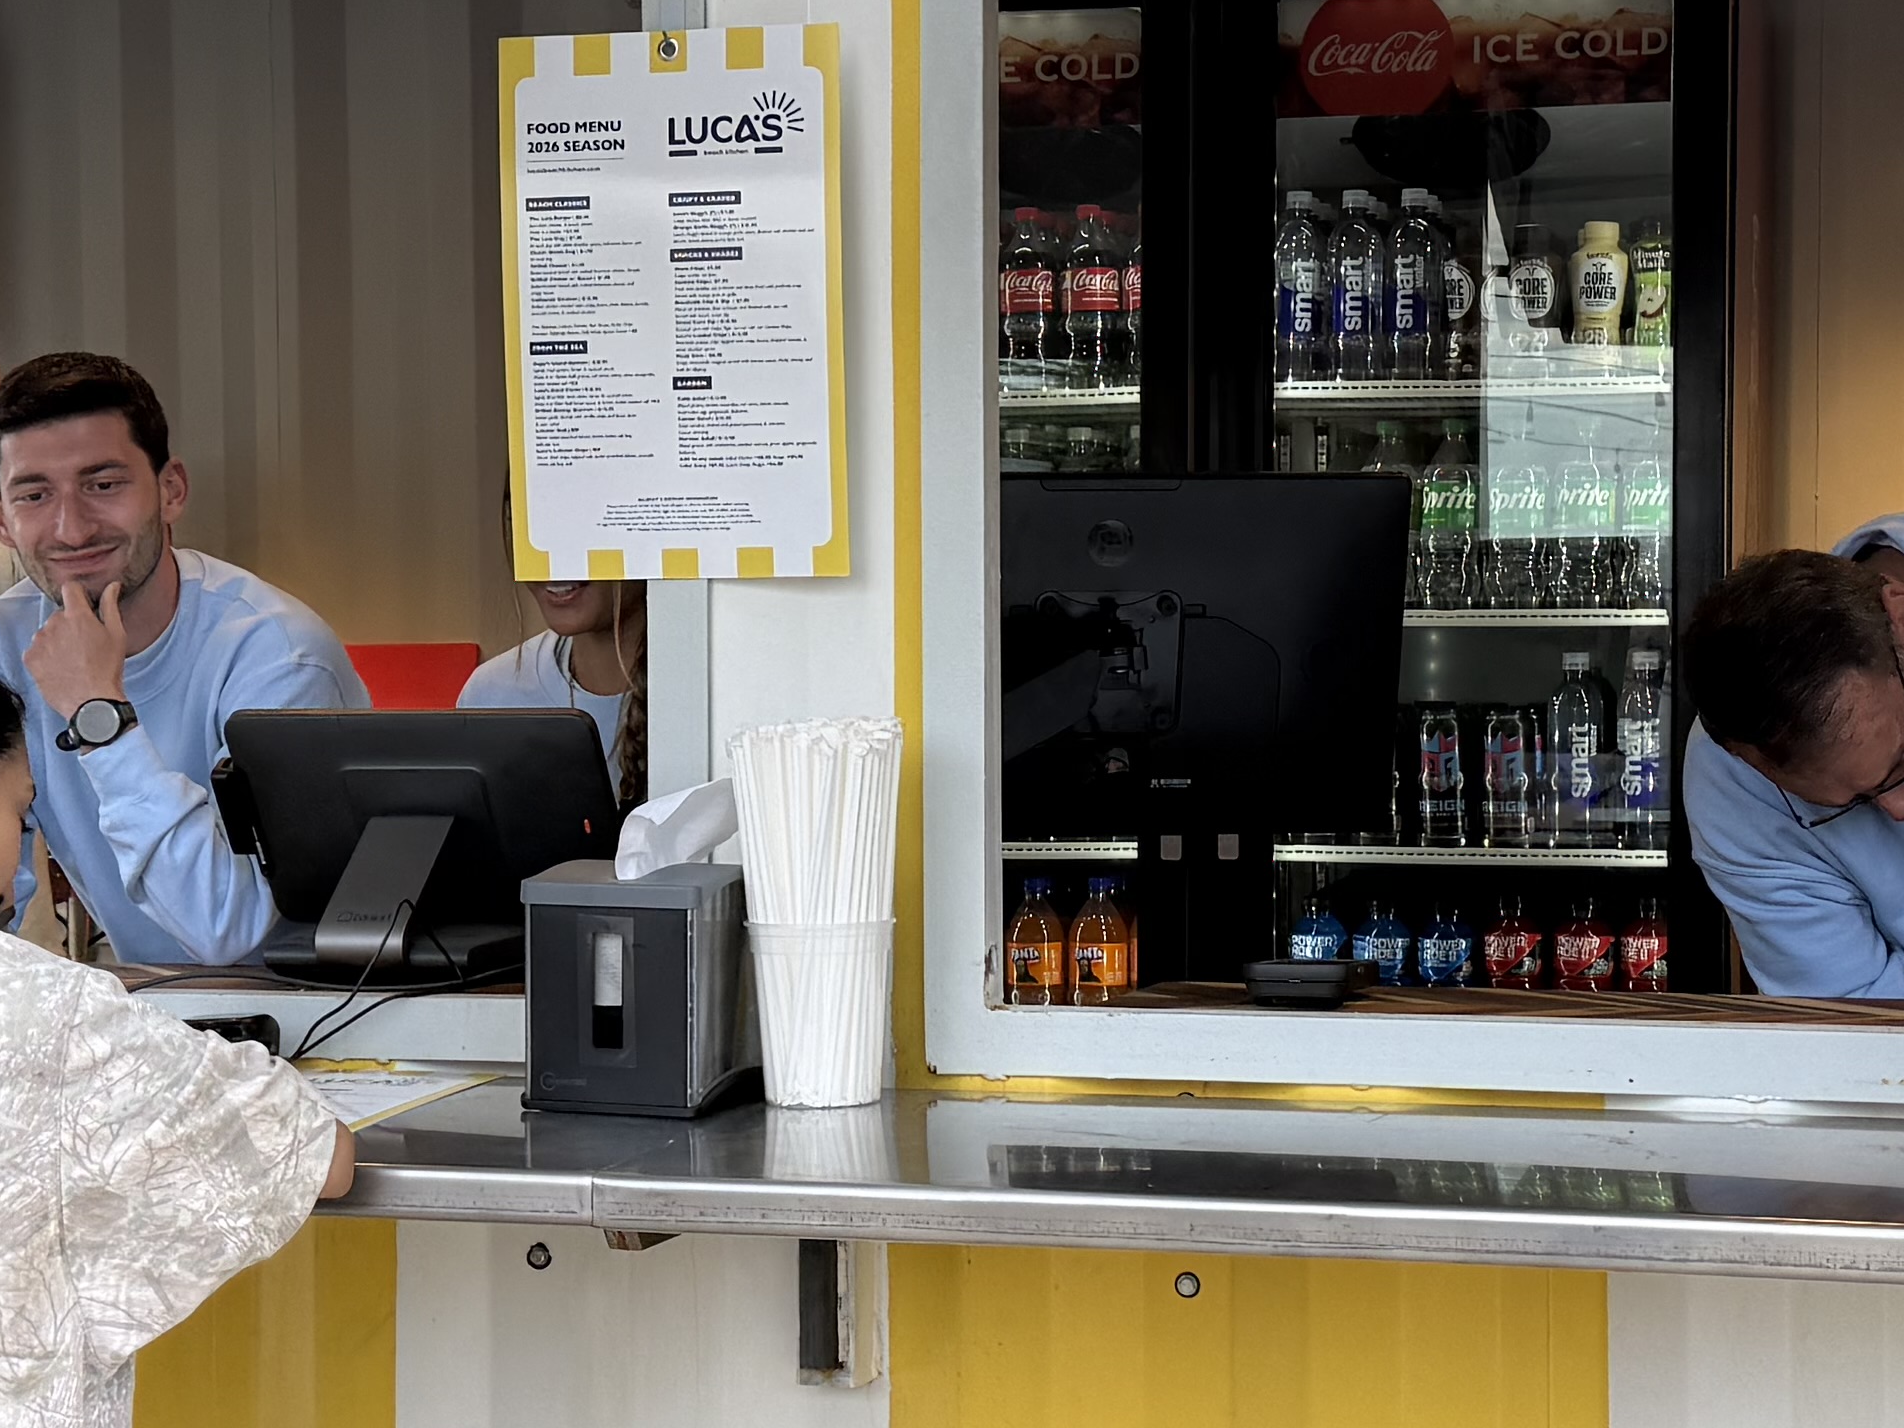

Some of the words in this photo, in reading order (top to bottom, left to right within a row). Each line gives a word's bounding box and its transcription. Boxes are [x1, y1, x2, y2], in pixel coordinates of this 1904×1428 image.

[1307, 29, 1445, 76] Coca-Cola
[1473, 33, 1539, 64] ICE
[1555, 28, 1668, 58] COLD
[1034, 53, 1140, 83] COLD
[527, 122, 570, 135] FOOD
[575, 120, 622, 133] MENU
[668, 113, 783, 145] LUCA'S
[527, 141, 560, 153] 2026
[563, 139, 625, 152] SEASON
[1395, 254, 1414, 329] smart
[1515, 278, 1548, 295] CORE
[1584, 272, 1613, 285] CORE
[1295, 257, 1314, 332] smart
[1341, 256, 1363, 331] smart
[1579, 286, 1617, 300] POWER
[1422, 486, 1476, 514] Sprite
[1489, 486, 1545, 514] Sprite
[1419, 799, 1465, 812] REIGN
[1291, 934, 1334, 947] POWER
